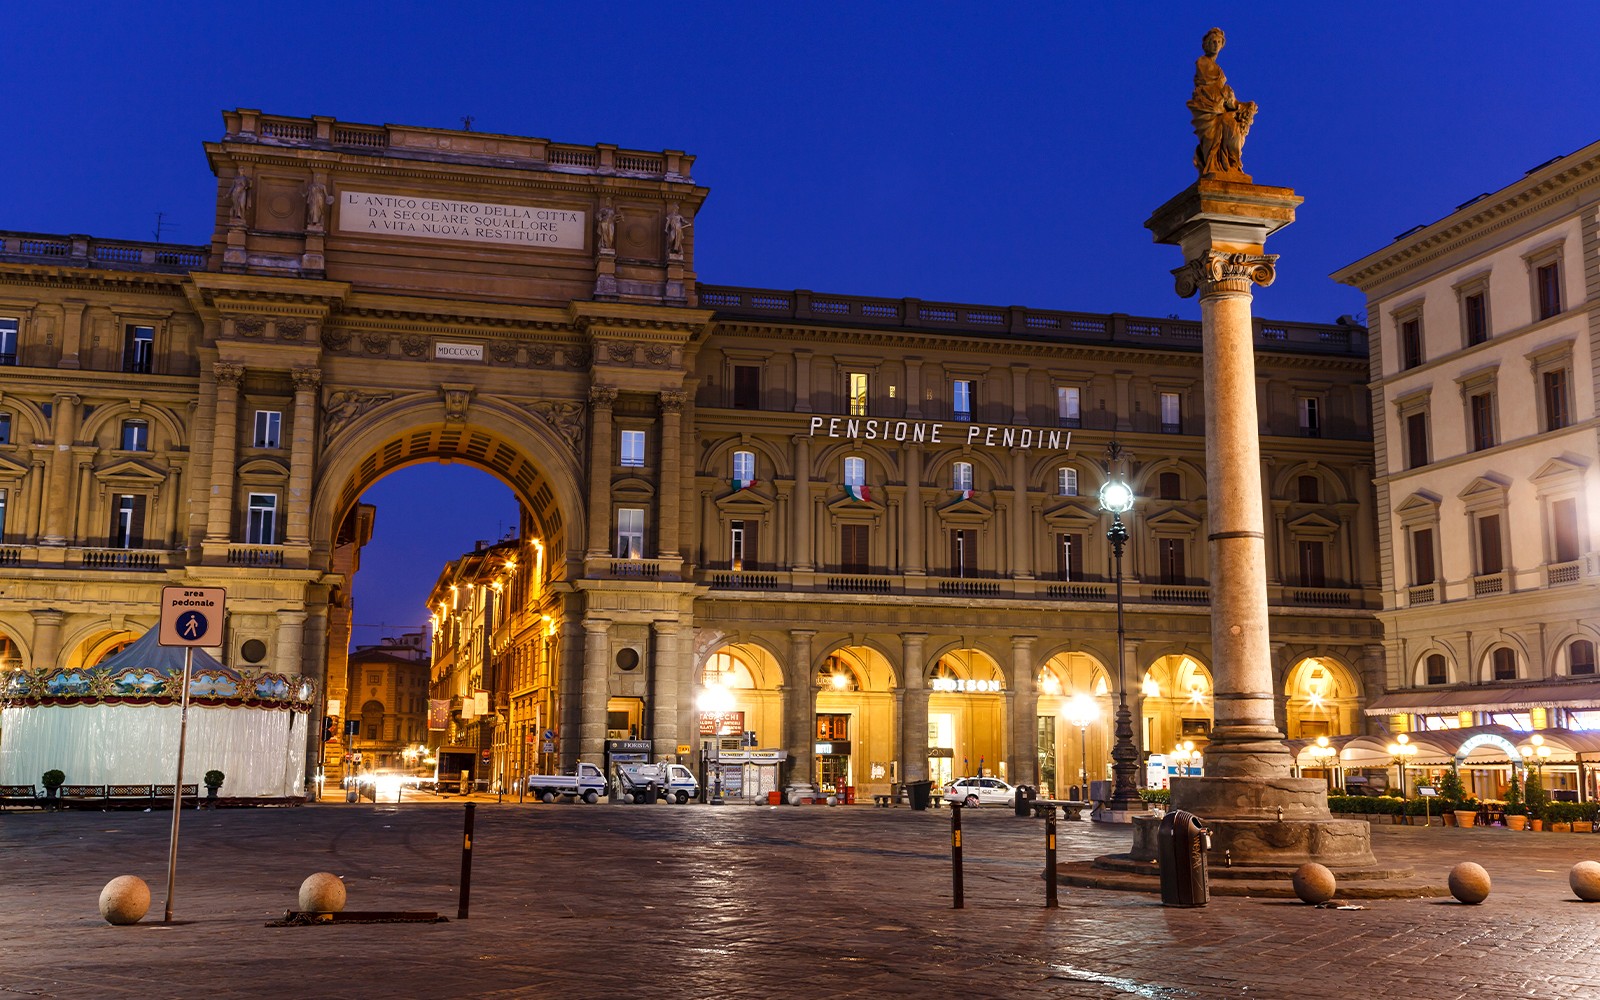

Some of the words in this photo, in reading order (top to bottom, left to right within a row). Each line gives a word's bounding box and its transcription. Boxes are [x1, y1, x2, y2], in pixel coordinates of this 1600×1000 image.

[365, 197, 417, 209] ANTICO
[422, 201, 479, 214] CENTRO
[484, 206, 531, 219] DELLA
[368, 208, 387, 218] DA
[393, 210, 469, 225] SECOLARE
[474, 216, 558, 232] SQUALLORE
[368, 220, 377, 229] A
[383, 220, 416, 232] VITA
[422, 223, 470, 236] NUOVA
[475, 228, 558, 243] RESTITUITO
[438, 346, 481, 356] MDCCCXCV
[810, 416, 943, 443] PENSIONE
[967, 426, 1072, 450] PENDINI
[172, 599, 214, 607] pedonale
[932, 678, 1000, 692] EDISON
